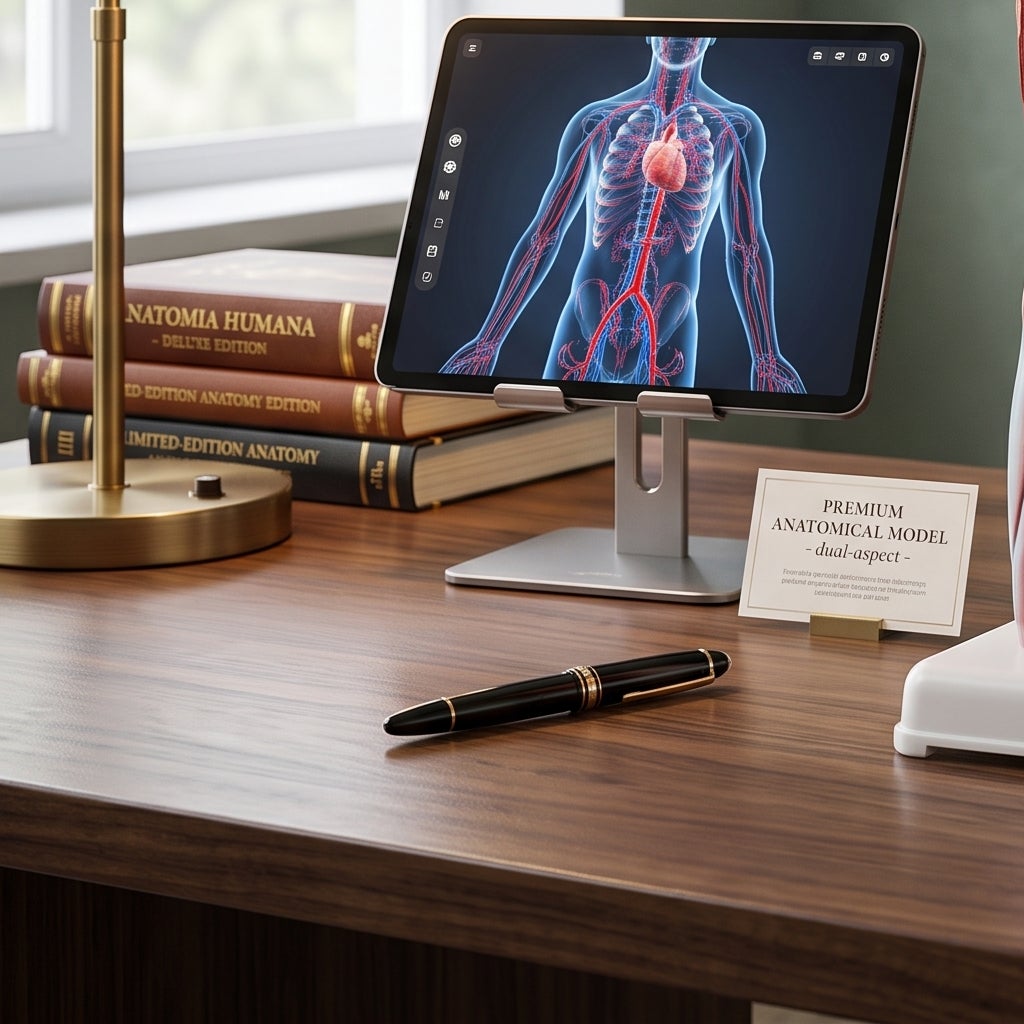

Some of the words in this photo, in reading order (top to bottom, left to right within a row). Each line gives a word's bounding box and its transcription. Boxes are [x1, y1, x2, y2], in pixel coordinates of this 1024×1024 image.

[125, 303, 219, 330] NATOMIA
[223, 310, 316, 338] HUMANA
[214, 338, 268, 355] EDITION
[125, 383, 197, 403] ED-EDITION
[199, 391, 263, 409] ANATOMY
[265, 396, 321, 414] EDITION
[246, 443, 320, 466] ANATOMY
[823, 499, 904, 519] PREMIUM
[772, 517, 883, 539] ANATOMICAL
[887, 526, 948, 545] MODEL
[815, 542, 901, 565] dual-aspect
